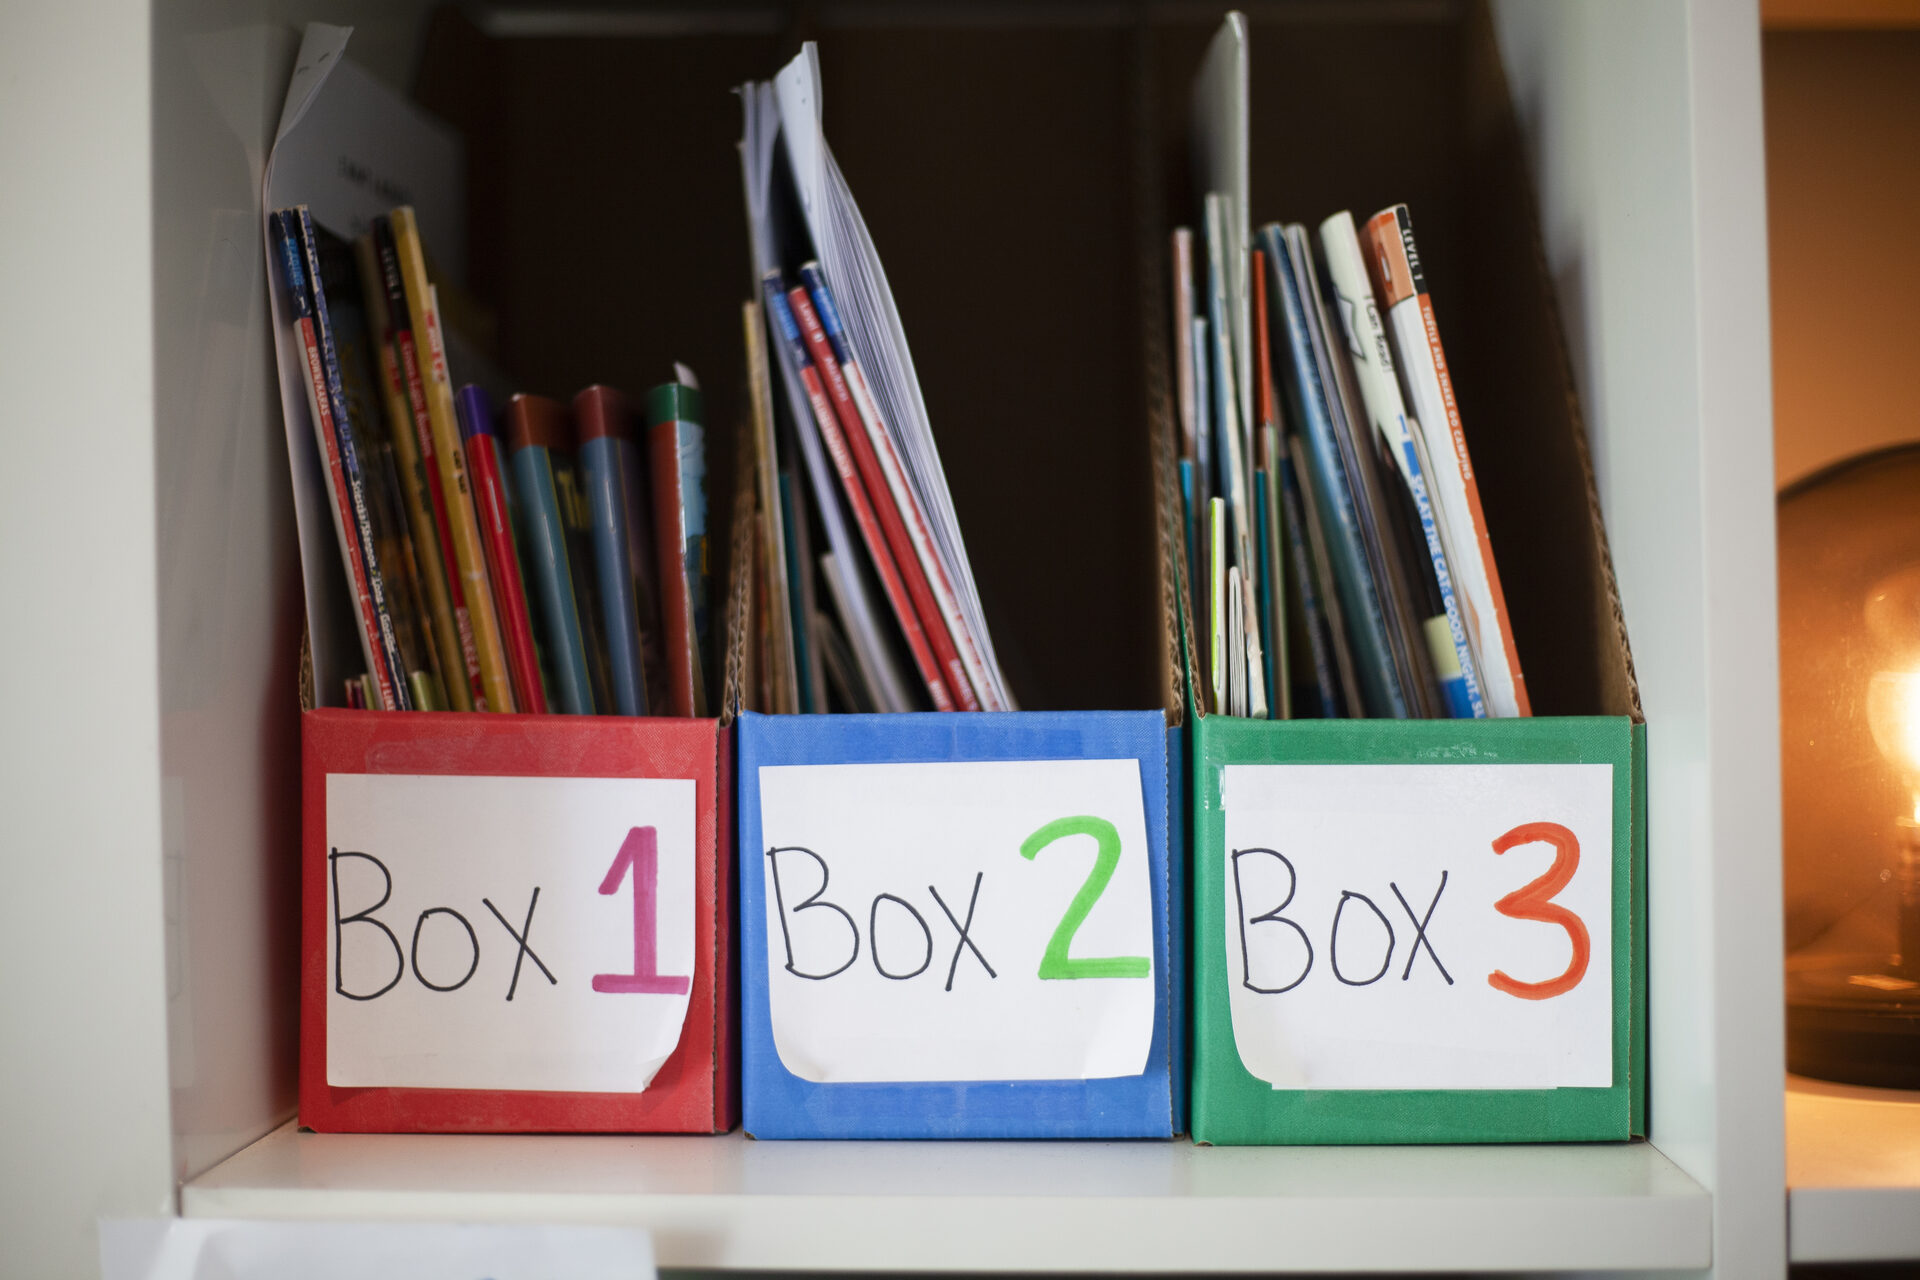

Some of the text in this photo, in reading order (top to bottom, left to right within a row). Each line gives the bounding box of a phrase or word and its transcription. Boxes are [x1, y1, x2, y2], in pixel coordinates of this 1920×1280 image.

[1402, 228, 1420, 269] LEVEL
[1423, 305, 1472, 481] TURTLE AND SNAKE GO CAMPING
[1411, 475, 1434, 518] SPLAT
[1423, 522, 1444, 554] THE
[1443, 594, 1467, 643] GOOD
[329, 825, 690, 1001] Box 1
[766, 815, 1151, 991] Box 2
[1231, 821, 1591, 1000] Box 3
